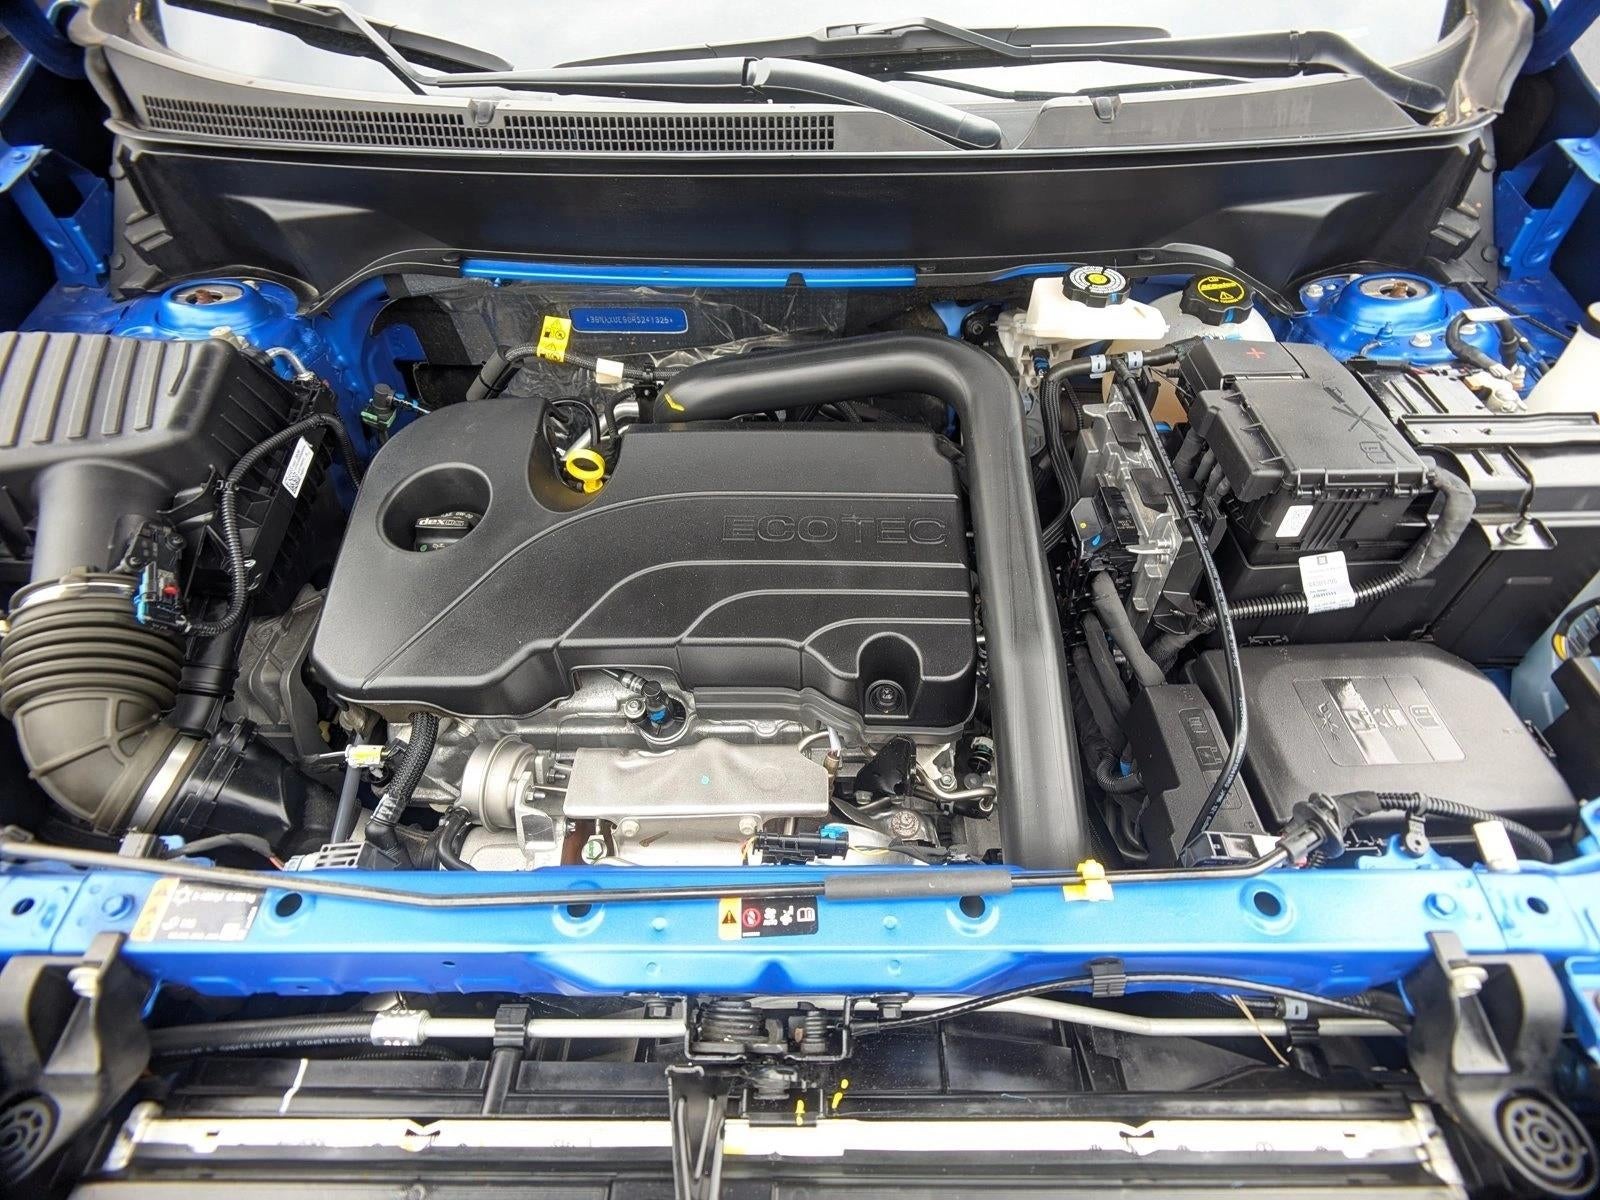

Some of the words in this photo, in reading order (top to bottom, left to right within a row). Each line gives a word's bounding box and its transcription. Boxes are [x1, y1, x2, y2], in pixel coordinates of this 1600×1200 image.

[418, 518, 465, 527] dexos
[722, 514, 946, 545] ECOTEC
[296, 1036, 373, 1047] CONSTRUCTIO
